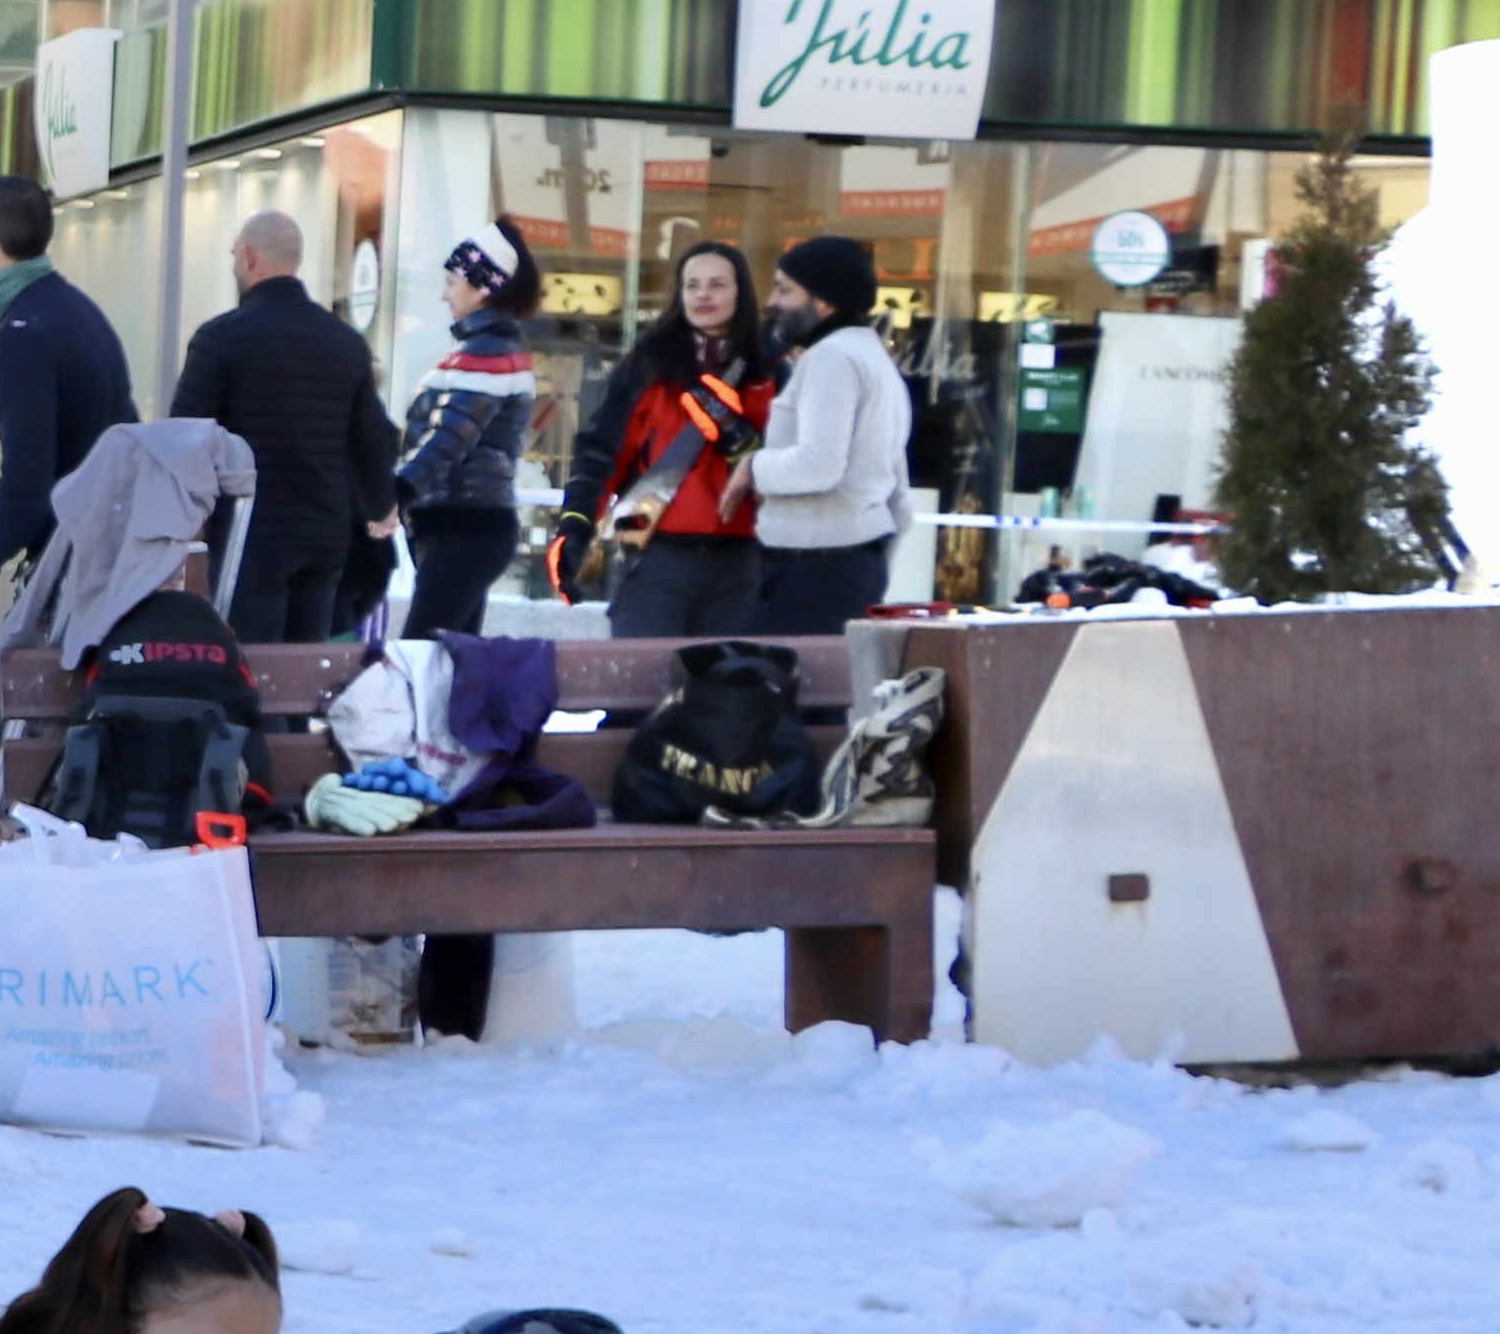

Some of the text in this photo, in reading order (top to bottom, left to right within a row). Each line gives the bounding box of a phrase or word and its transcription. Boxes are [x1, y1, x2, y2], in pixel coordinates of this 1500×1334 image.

[822, 76, 968, 96] PERFUMERIA
[6, 1027, 86, 1049] Amazing
[34, 1048, 115, 1070] Amazing
